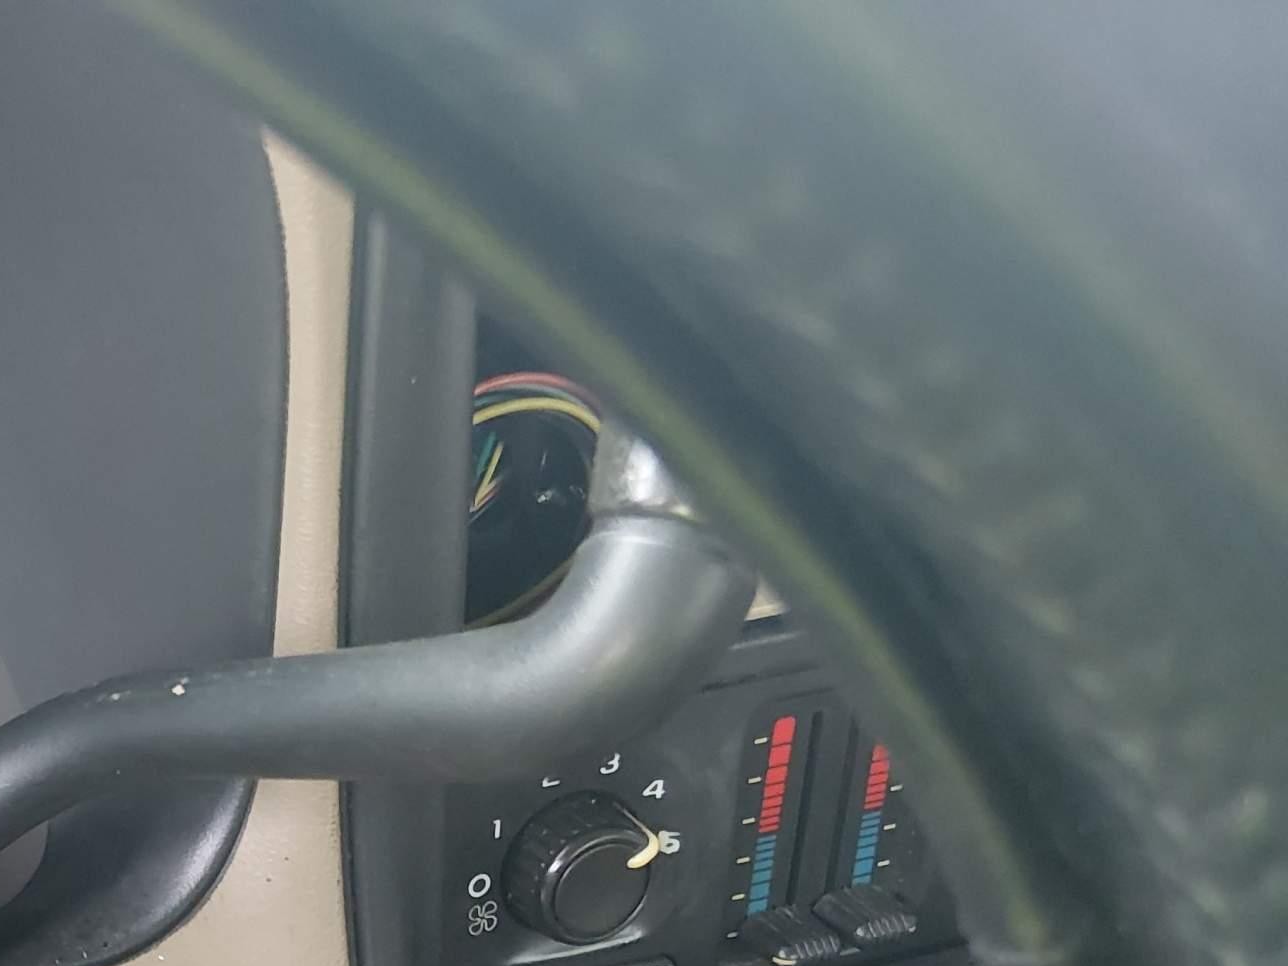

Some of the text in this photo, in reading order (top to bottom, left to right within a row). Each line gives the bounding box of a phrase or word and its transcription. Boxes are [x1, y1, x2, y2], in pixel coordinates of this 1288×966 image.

[642, 779, 666, 799] 4
[491, 818, 503, 840] 1
[656, 829, 682, 855] 5
